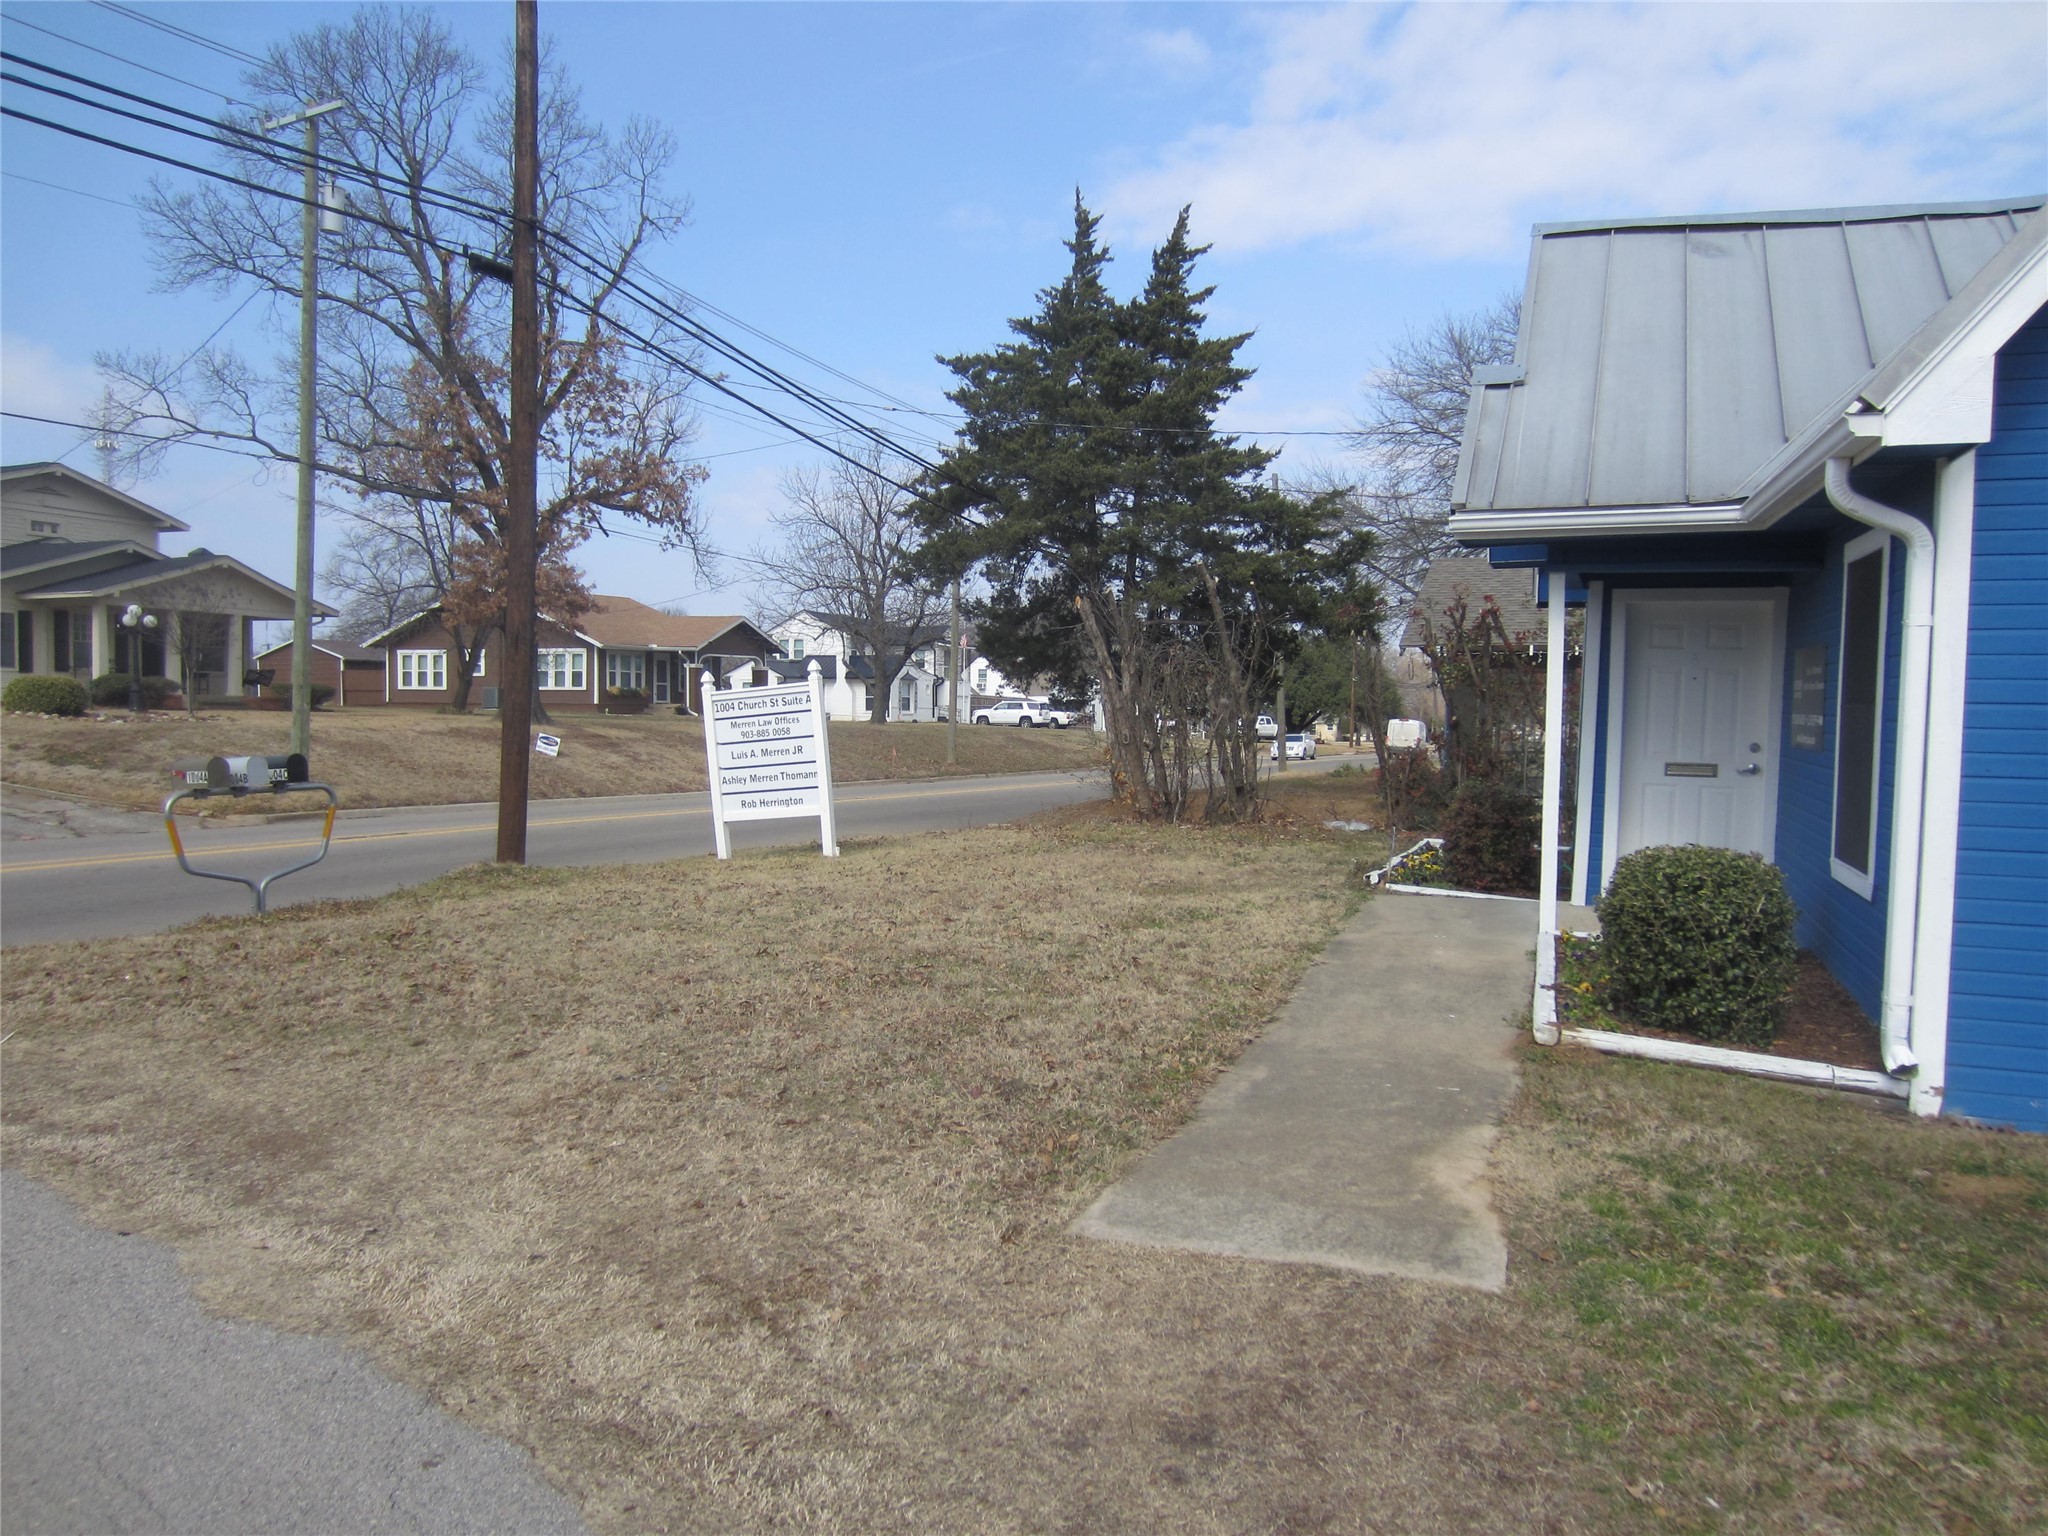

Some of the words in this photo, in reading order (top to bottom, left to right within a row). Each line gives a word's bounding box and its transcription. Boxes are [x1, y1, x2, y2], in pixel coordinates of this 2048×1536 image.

[715, 702, 735, 713] 1004
[738, 699, 767, 710] Church
[770, 698, 779, 707] St
[781, 696, 803, 706] Suite
[805, 694, 811, 704] A
[730, 720, 756, 729] Merren
[758, 719, 772, 727] Law
[774, 716, 800, 725] Offices
[741, 728, 770, 739] 903-885
[772, 727, 791, 736] 0058
[731, 750, 748, 760] Luis
[750, 749, 758, 758] A.
[761, 748, 790, 757] Merren
[792, 745, 803, 755] JR
[722, 776, 747, 785] Ashley
[749, 774, 779, 783] Merren
[741, 799, 757, 808] Rob
[759, 797, 804, 808] Herrington
